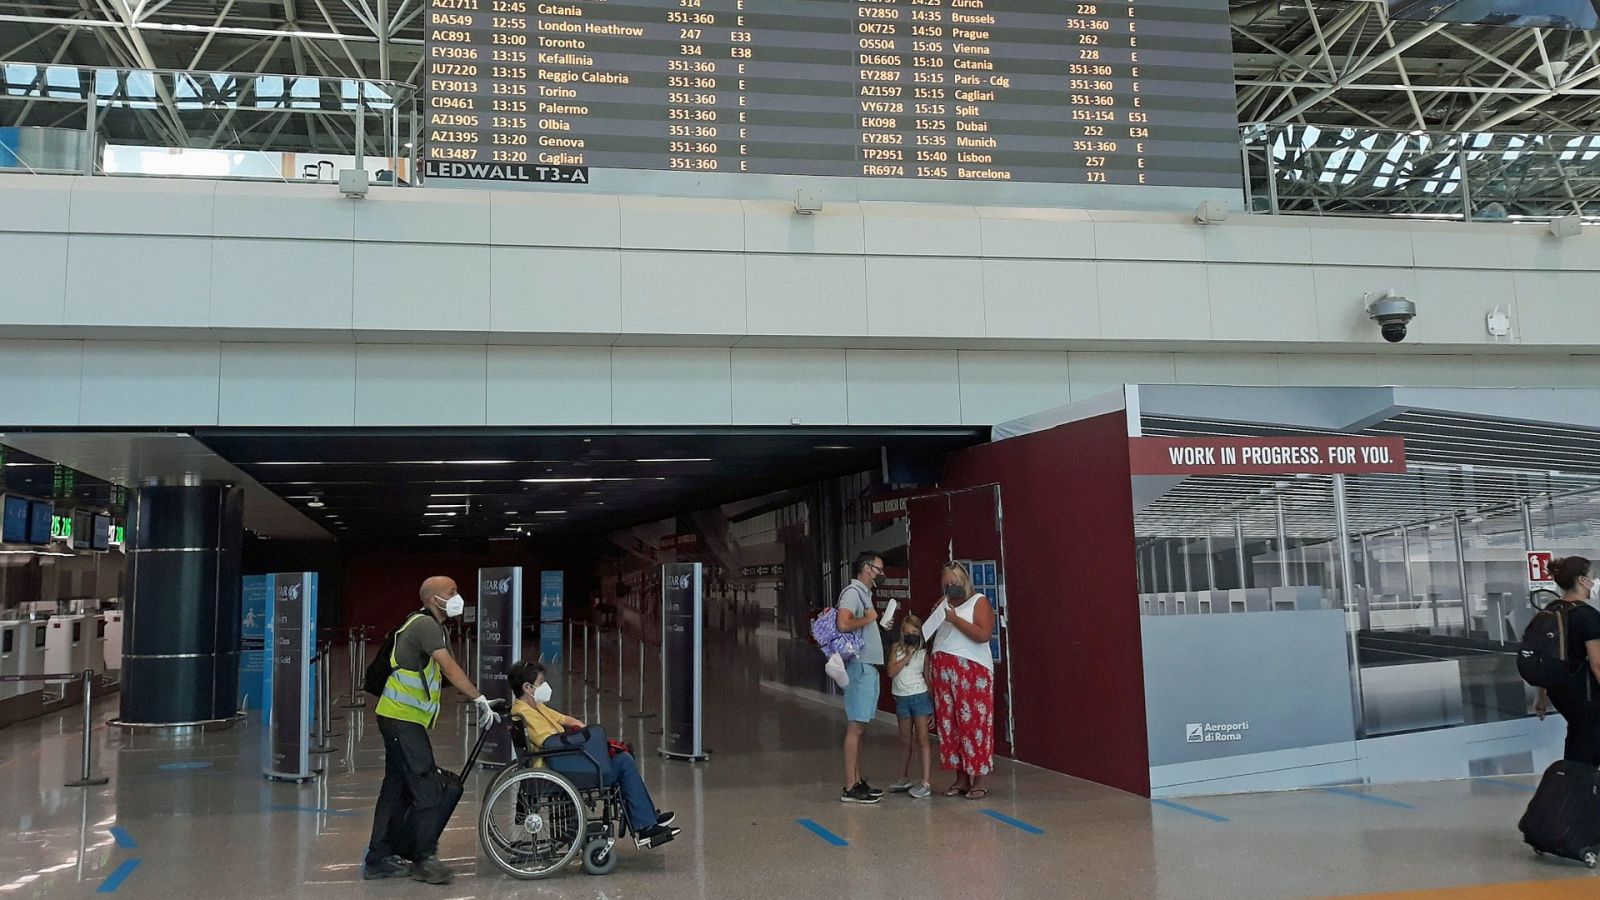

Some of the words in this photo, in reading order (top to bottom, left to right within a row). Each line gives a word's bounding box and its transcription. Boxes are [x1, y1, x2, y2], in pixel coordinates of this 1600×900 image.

[492, 0, 527, 13] 12:45
[537, 3, 582, 17] Catania
[667, 11, 715, 25] 351-360
[858, 7, 899, 19] EY2850
[911, 10, 942, 22] 14:35
[951, 12, 996, 25] Brussels
[1066, 18, 1110, 31] 351-360
[1077, 4, 1097, 15] 228
[431, 13, 473, 26] BA549
[492, 17, 527, 30] 12:55
[538, 19, 582, 33] London
[584, 22, 644, 37] Heathrow
[680, 28, 702, 40] 247
[730, 31, 752, 43] E33
[858, 22, 896, 35] OK725
[912, 25, 943, 37] 14:50
[952, 27, 990, 41] Prague
[1079, 34, 1099, 45] 262
[431, 29, 472, 43] AC891
[492, 33, 527, 46] 13:00
[537, 36, 586, 49] Toronto
[680, 44, 702, 56] 334
[730, 47, 752, 59] E38
[859, 38, 895, 50] OS504
[912, 40, 943, 53] 15:05
[952, 42, 990, 55] Vienna
[1079, 49, 1100, 60] 228
[431, 46, 478, 60] EY3036
[492, 50, 527, 62] 13:15
[538, 52, 594, 66] Kefallinia
[667, 59, 716, 73] 351-360
[859, 53, 902, 66] DL6605
[912, 56, 944, 68] 15:10
[953, 58, 994, 70] Catania
[1069, 63, 1112, 76] 351-360
[431, 63, 478, 76] JU7220
[492, 66, 527, 79] 13:15
[538, 69, 579, 83] Reggio
[581, 71, 629, 84] Calabria
[668, 76, 716, 89] 351-360
[860, 69, 901, 82] EY2887
[913, 72, 944, 84] 15:15
[954, 74, 980, 86] Paris
[989, 75, 1010, 89] Cdg
[1069, 79, 1113, 91] 351-360
[431, 79, 478, 93] EY3013
[492, 83, 527, 95] 13:15
[538, 85, 577, 98] Torino
[668, 92, 717, 105] 351-360
[860, 85, 902, 97] AZ1597
[914, 87, 945, 99] 15:15
[954, 89, 994, 103] Cagliari
[1070, 94, 1114, 106] 351-360
[431, 96, 475, 110] CI9461
[492, 99, 527, 112] 13:15
[538, 102, 589, 115] Palermo
[668, 108, 717, 121] 351-360
[860, 101, 904, 113] VY6728
[914, 103, 946, 115] 15:15
[955, 105, 980, 118] Split
[1071, 109, 1115, 121] 151-154
[1128, 111, 1148, 123] E51
[430, 113, 479, 127] AZ1905
[492, 116, 527, 129] 13:15
[538, 118, 571, 131] Olbia
[669, 125, 717, 138] 351-360
[861, 117, 897, 129] EK098
[915, 119, 946, 130] 15:25
[956, 120, 988, 132] Dubai
[1083, 125, 1104, 136] 252
[1129, 127, 1149, 138] E34
[430, 130, 479, 143] AZ1395
[492, 133, 527, 145] 13:20
[538, 135, 585, 148] Genova
[669, 141, 717, 154] 351-360
[862, 132, 903, 145] EY2852
[915, 135, 947, 146] 15:35
[956, 136, 997, 148] Munich
[1073, 140, 1117, 152] 351-360
[431, 147, 478, 160] KL3487
[492, 150, 528, 162] 13:20
[538, 152, 584, 166] Cagliari
[669, 157, 718, 170] 351-360
[862, 148, 904, 161] TP2951
[916, 150, 948, 162] 15:40
[957, 151, 992, 163] Lisbon
[1085, 156, 1106, 167] 257
[426, 161, 530, 180] LEDWALL
[535, 166, 587, 183] T3-A
[863, 164, 905, 176] FR6974
[916, 166, 948, 178] 15:45
[957, 167, 1011, 180] Barcelona
[1086, 171, 1107, 183] 171
[1168, 446, 1216, 466] WORK
[1220, 446, 1237, 465] IN
[1241, 446, 1324, 465] PROGRESS.
[1327, 446, 1357, 464] FOR
[1360, 446, 1394, 464] YOU.
[1203, 720, 1250, 733] Aeroporti
[1204, 732, 1214, 742] di
[1214, 732, 1242, 742] Roma
